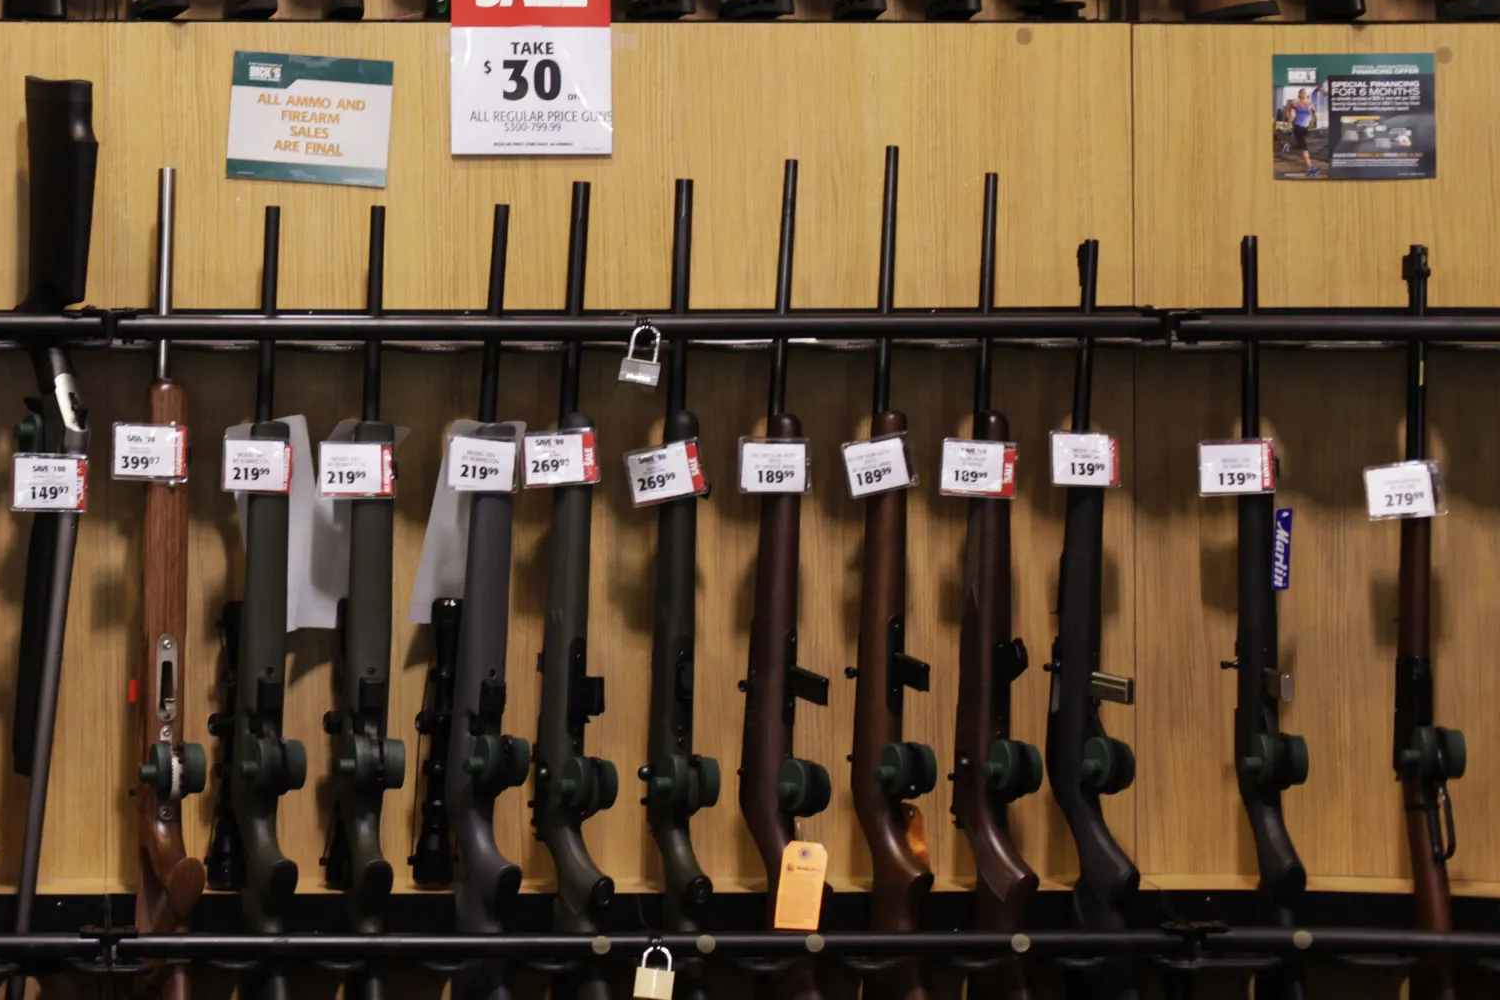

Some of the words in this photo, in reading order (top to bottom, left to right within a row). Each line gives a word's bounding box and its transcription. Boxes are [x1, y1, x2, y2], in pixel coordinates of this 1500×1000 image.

[510, 42, 554, 55] TAKE
[1331, 88, 1356, 96] FOR
[1359, 88, 1367, 96] 6
[1369, 87, 1420, 96] MONTHS
[257, 93, 281, 105] ALL
[286, 95, 331, 109] AMMO
[336, 99, 366, 111] AND
[281, 110, 340, 124] FIREARM
[470, 110, 490, 122] ALL
[493, 110, 544, 122] REGULAR
[548, 110, 577, 122] PRICE
[290, 125, 329, 139] SALES
[504, 123, 561, 132] $300-799.99
[274, 140, 300, 152] ARE
[305, 142, 343, 157] FINAL
[583, 448, 593, 466] SALE
[32, 465, 48, 473] SAVE
[687, 457, 700, 476] SALE
[1003, 462, 1013, 484] SALE
[1273, 521, 1290, 587] Marlin
